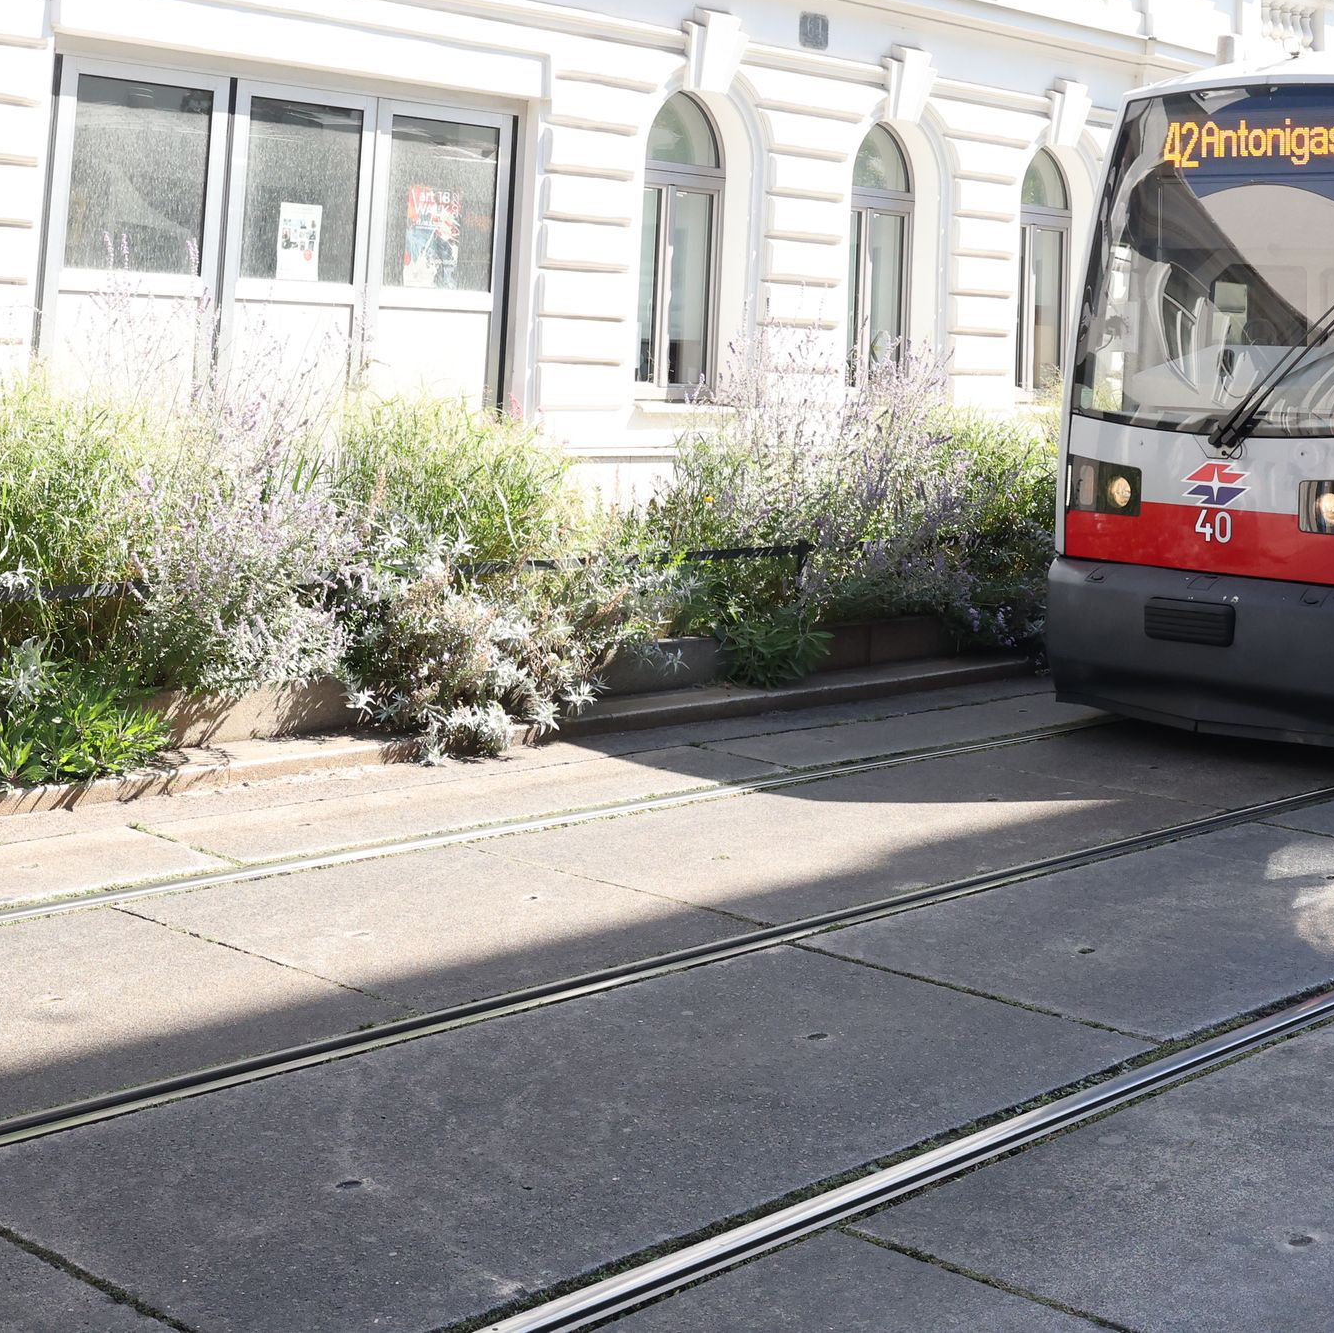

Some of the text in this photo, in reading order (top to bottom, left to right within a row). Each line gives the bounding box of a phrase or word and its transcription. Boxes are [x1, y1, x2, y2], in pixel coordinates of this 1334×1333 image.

[1163, 121, 1199, 168] 42
[437, 191, 451, 203] 18
[1194, 508, 1232, 544] 40
